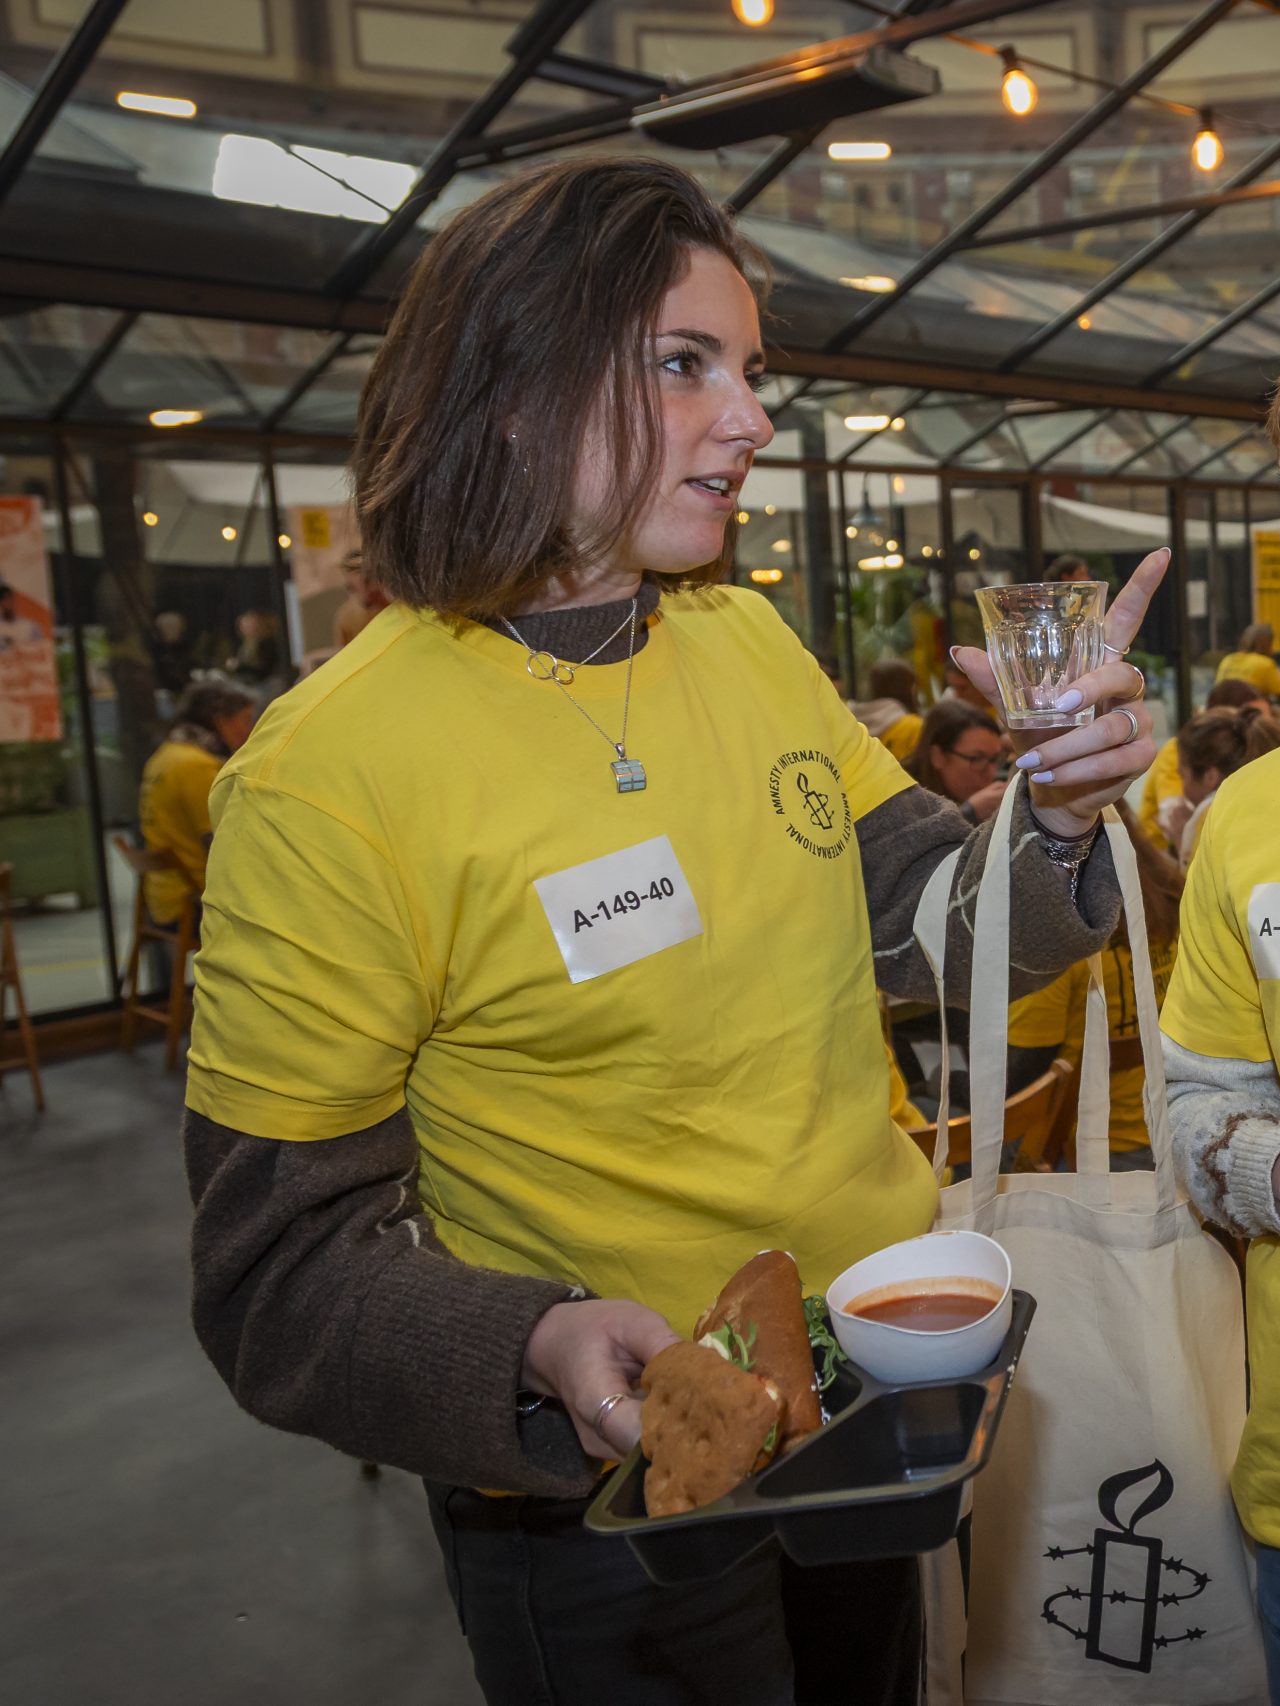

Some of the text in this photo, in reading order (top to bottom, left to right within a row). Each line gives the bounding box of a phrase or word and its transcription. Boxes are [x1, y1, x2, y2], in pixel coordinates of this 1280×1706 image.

[769, 750, 841, 815] AMNESTY INTERNATIONAL
[786, 792, 852, 859] AMNESTY INTERNATIONAL
[573, 876, 675, 933] A-149-40
